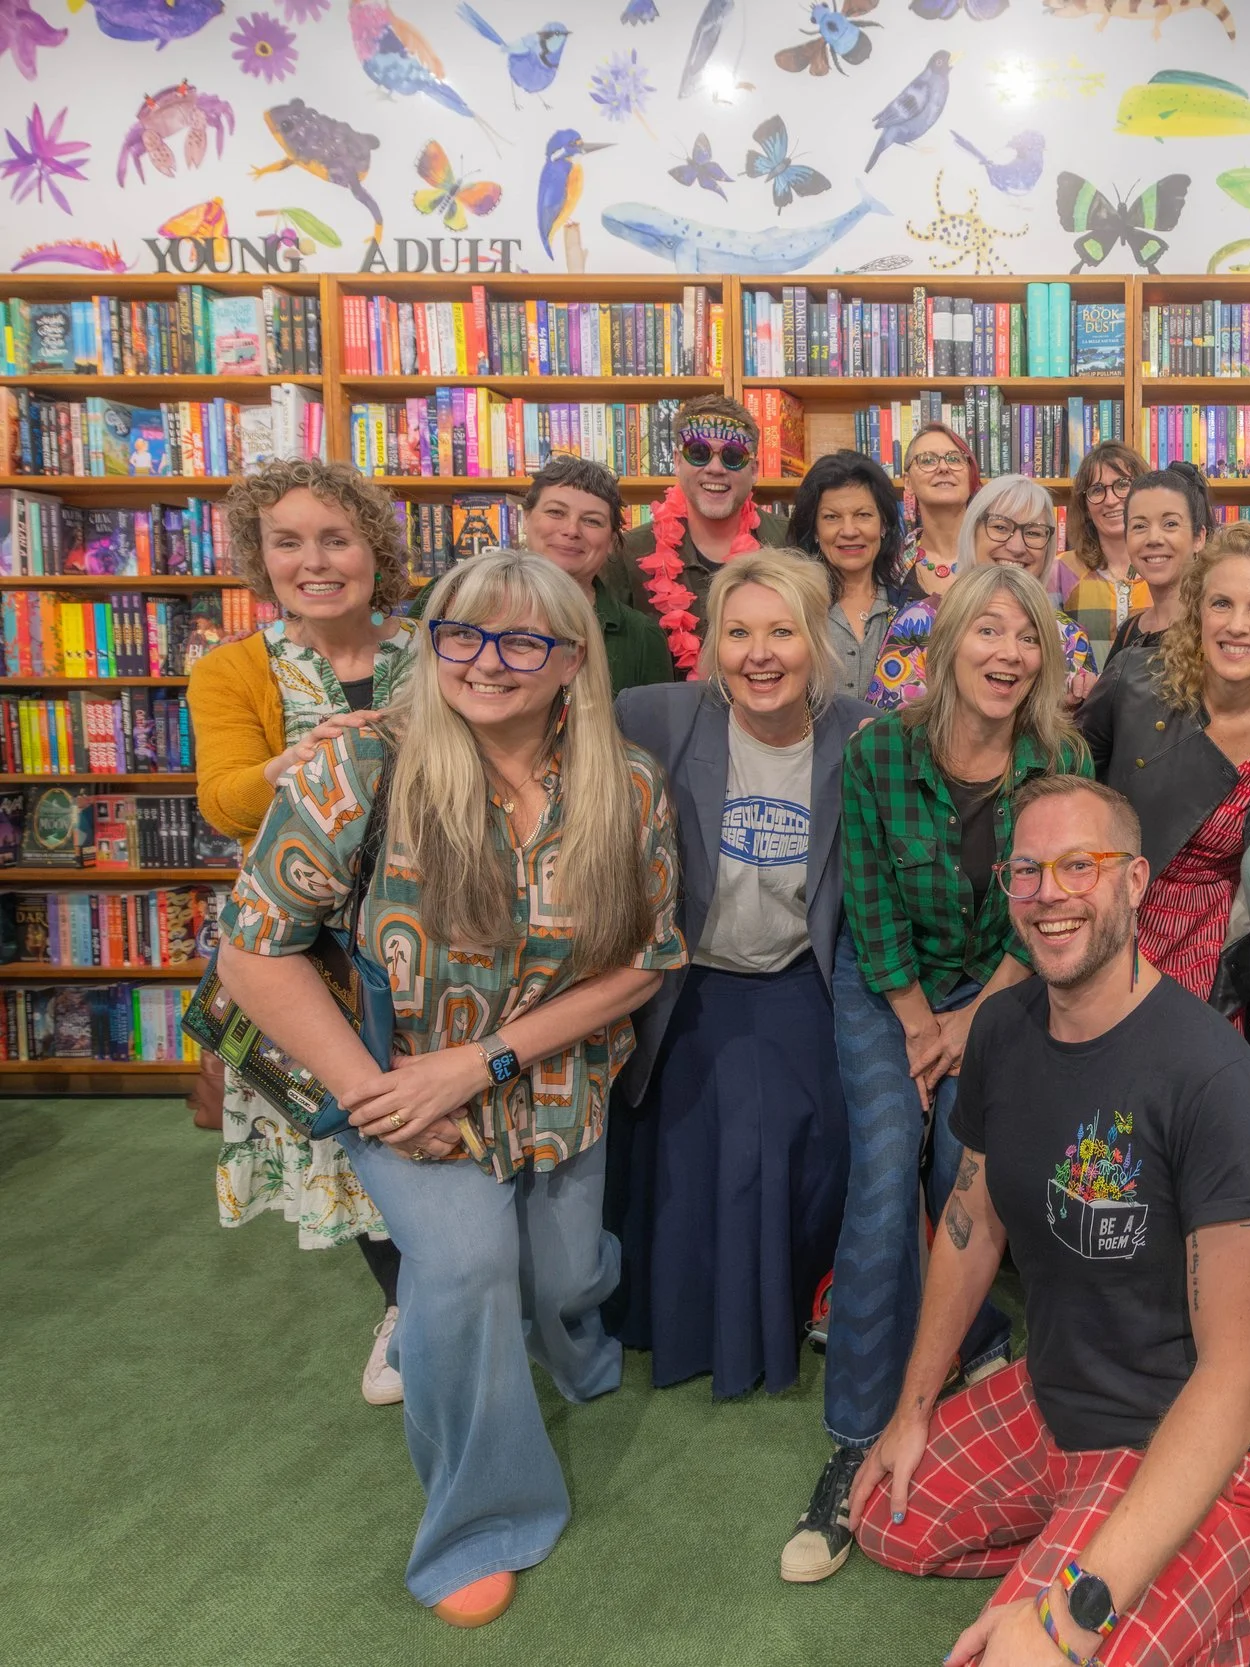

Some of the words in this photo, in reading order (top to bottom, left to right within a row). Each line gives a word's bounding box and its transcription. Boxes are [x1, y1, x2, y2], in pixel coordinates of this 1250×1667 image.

[142, 237, 304, 274] YOUNG
[358, 237, 522, 273] ADULT
[783, 299, 794, 331] DARK
[795, 299, 806, 332] DARK
[1083, 309, 1119, 321] BOOK
[1085, 321, 1117, 333] DUST
[613, 343, 621, 358] KING
[625, 340, 633, 361] KNIGHT
[783, 335, 794, 362] RISE
[795, 334, 806, 362] HEIR
[965, 397, 975, 428] Reckless
[977, 399, 988, 433] Powerless
[358, 421, 367, 463] GEMINA
[375, 421, 384, 464] OBSIDIO
[680, 427, 753, 444] BIRTHDAY
[1034, 437, 1042, 472] LUMINOUS
[433, 505, 443, 526] NEVER
[19, 521, 27, 548] PLAN
[422, 526, 431, 553] MONSTER
[434, 531, 443, 551] HERO
[1058, 523, 1066, 552] CHAMPIONS
[87, 703, 96, 735] OXFORD
[95, 703, 104, 735] OXFORD
[104, 703, 114, 735] OXFORD
[179, 708, 188, 736] FRIEND
[90, 742, 98, 768] BLOOD
[99, 742, 107, 768] BLOOD
[107, 742, 116, 768] BLOOD
[180, 736, 190, 767] SCHEME
[1099, 1217, 1117, 1235] BE
[1124, 1214, 1135, 1232] A
[1098, 1235, 1130, 1250] POEM
